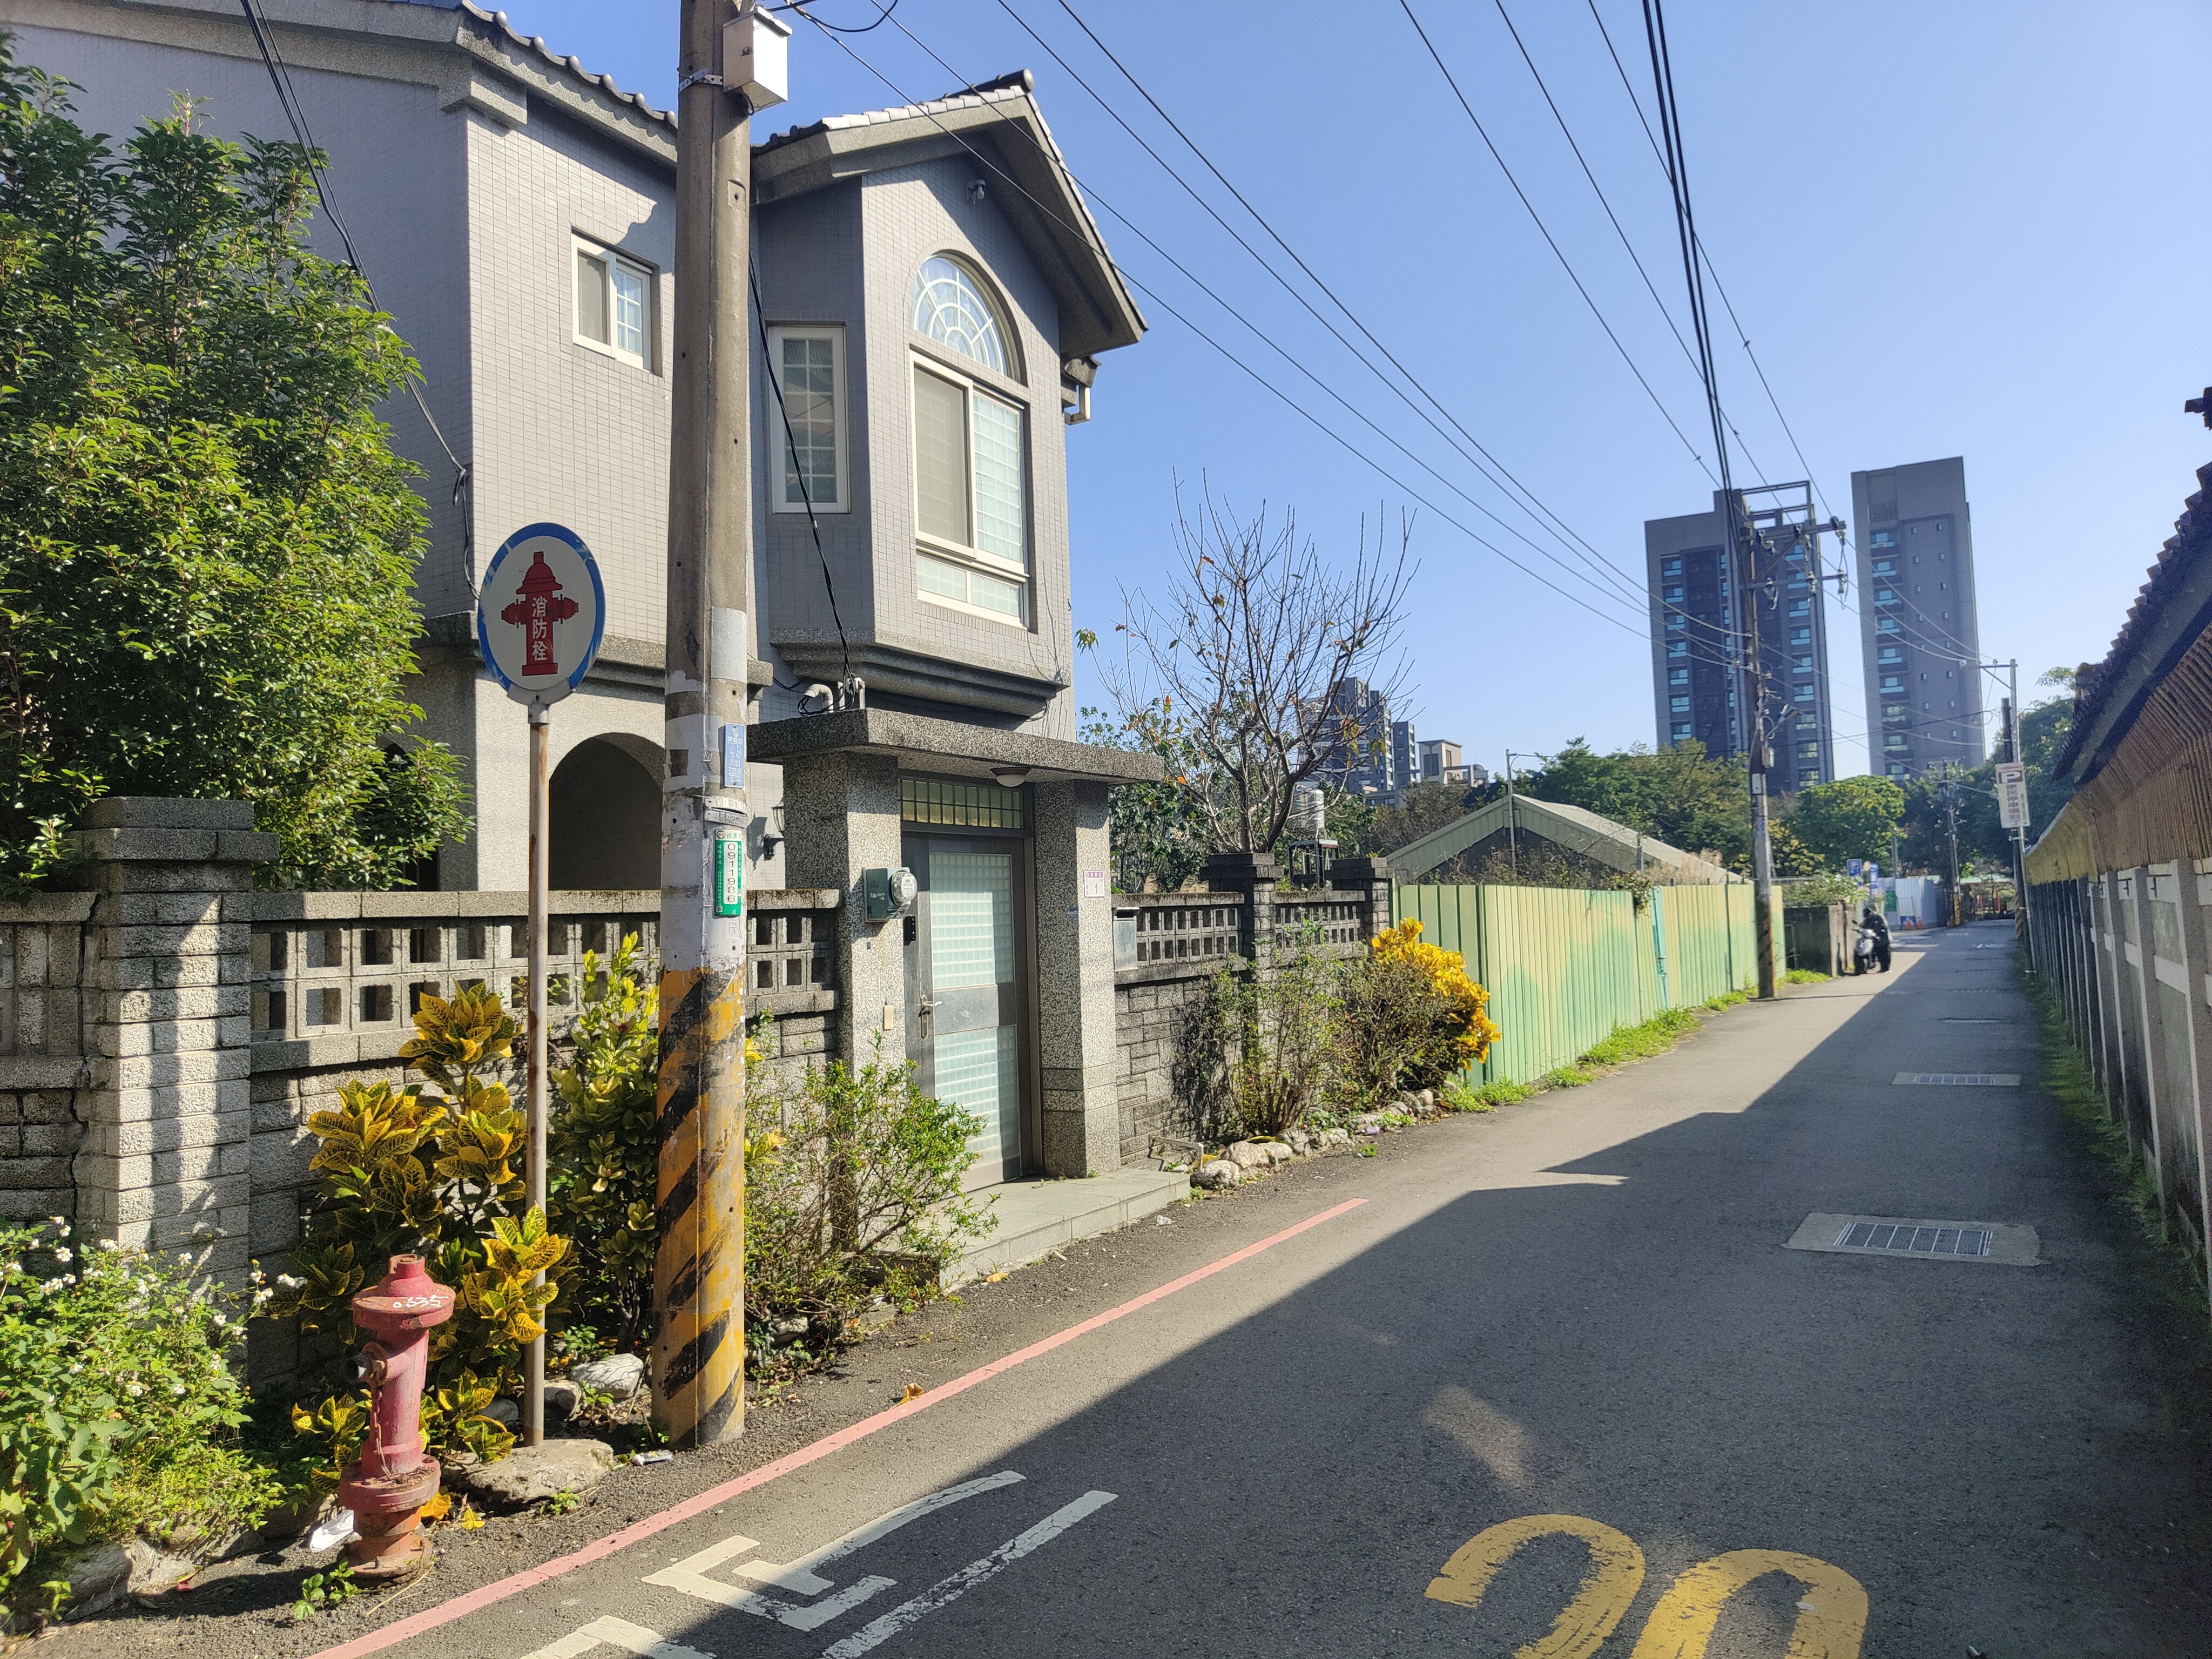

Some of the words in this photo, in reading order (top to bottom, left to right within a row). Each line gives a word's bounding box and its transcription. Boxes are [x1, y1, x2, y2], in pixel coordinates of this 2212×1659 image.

[532, 597, 548, 662] 消防栓
[2001, 771, 2021, 783] P
[727, 843, 736, 902] 0911986
[1095, 882, 1098, 895] 1
[729, 922, 737, 933] R
